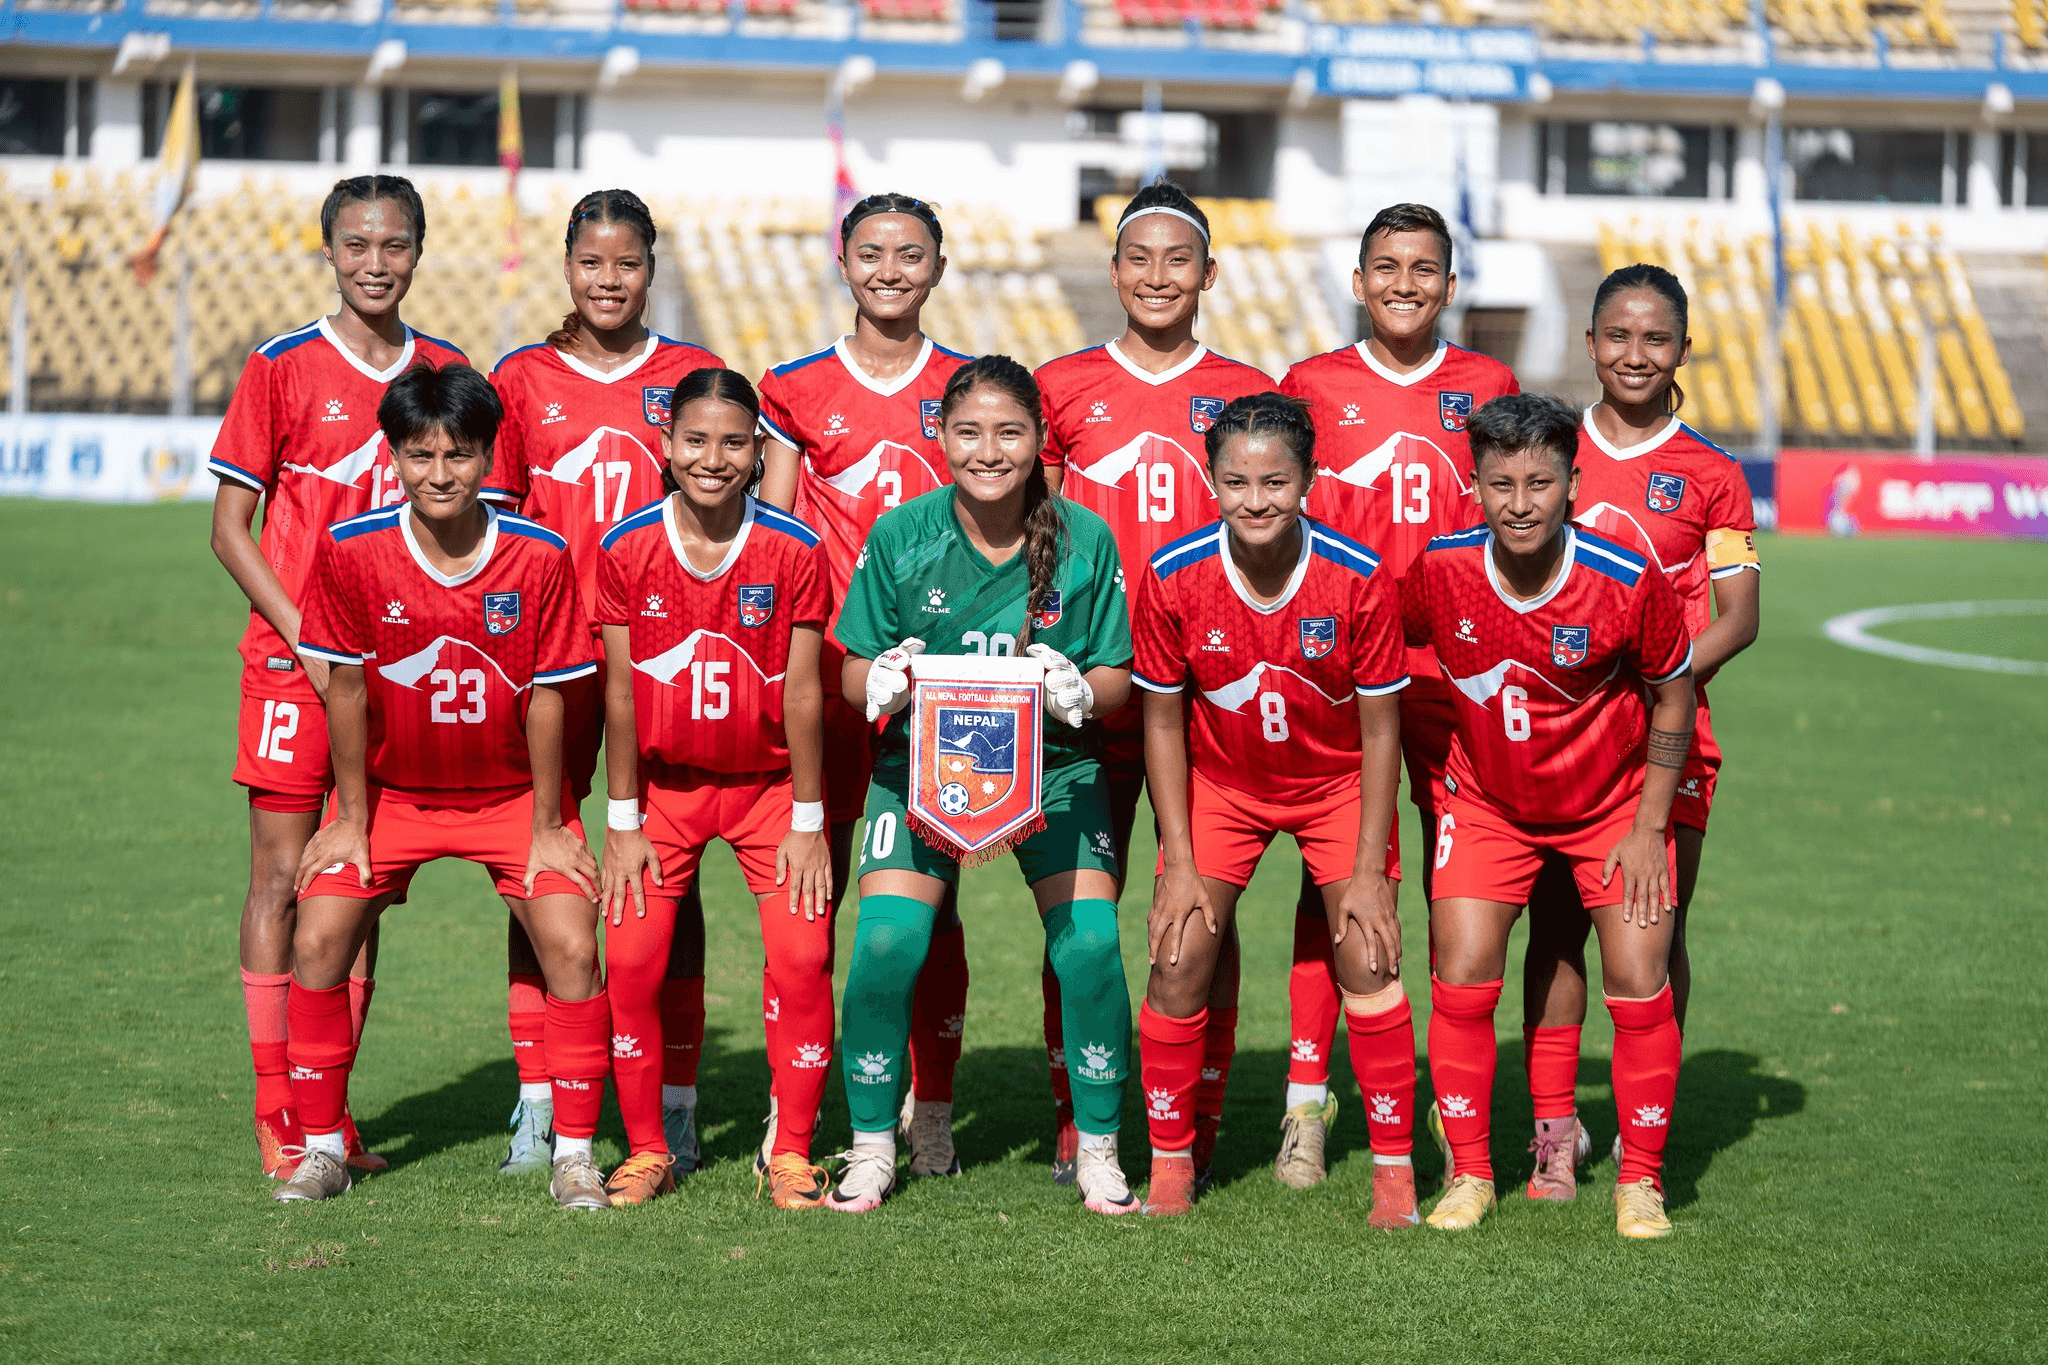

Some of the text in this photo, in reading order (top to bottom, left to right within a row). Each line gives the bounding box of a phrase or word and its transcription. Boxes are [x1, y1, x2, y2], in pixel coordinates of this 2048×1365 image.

[321, 415, 350, 423] KELME
[541, 415, 567, 425] KELME
[1086, 416, 1113, 424] KELME
[1338, 418, 1366, 426] KELME
[823, 427, 850, 436] KELME
[592, 460, 632, 523] 17
[877, 470, 902, 518] 3
[1135, 462, 1175, 523] 19
[1390, 462, 1431, 524] 13
[640, 610, 668, 619] KELME
[921, 605, 951, 615] KELME
[381, 616, 410, 625] KELME
[1455, 631, 1479, 645] KELME
[1202, 645, 1230, 653] KELME
[430, 668, 486, 724] 23
[691, 661, 730, 720] 15
[925, 691, 1031, 704] ALL NEPAL FOOTBALL ASSOCIATION
[1259, 691, 1290, 742] 8
[1502, 685, 1531, 742] 6
[953, 714, 1000, 727] NEPAL
[257, 699, 300, 764] 12
[1677, 787, 1701, 800] KELME
[1435, 813, 1457, 870] 6
[1091, 847, 1115, 860] KELME
[1291, 1051, 1320, 1063] KELME
[792, 1059, 829, 1069] KELME
[291, 1071, 323, 1081] KELME
[1077, 1065, 1117, 1079] KELME
[555, 1078, 590, 1091] KELME
[852, 1073, 892, 1085] KELME
[1148, 1108, 1180, 1121] KELME
[1370, 1111, 1401, 1125] KELME
[1441, 1108, 1477, 1119] KELME
[1631, 1117, 1667, 1128] KELME
